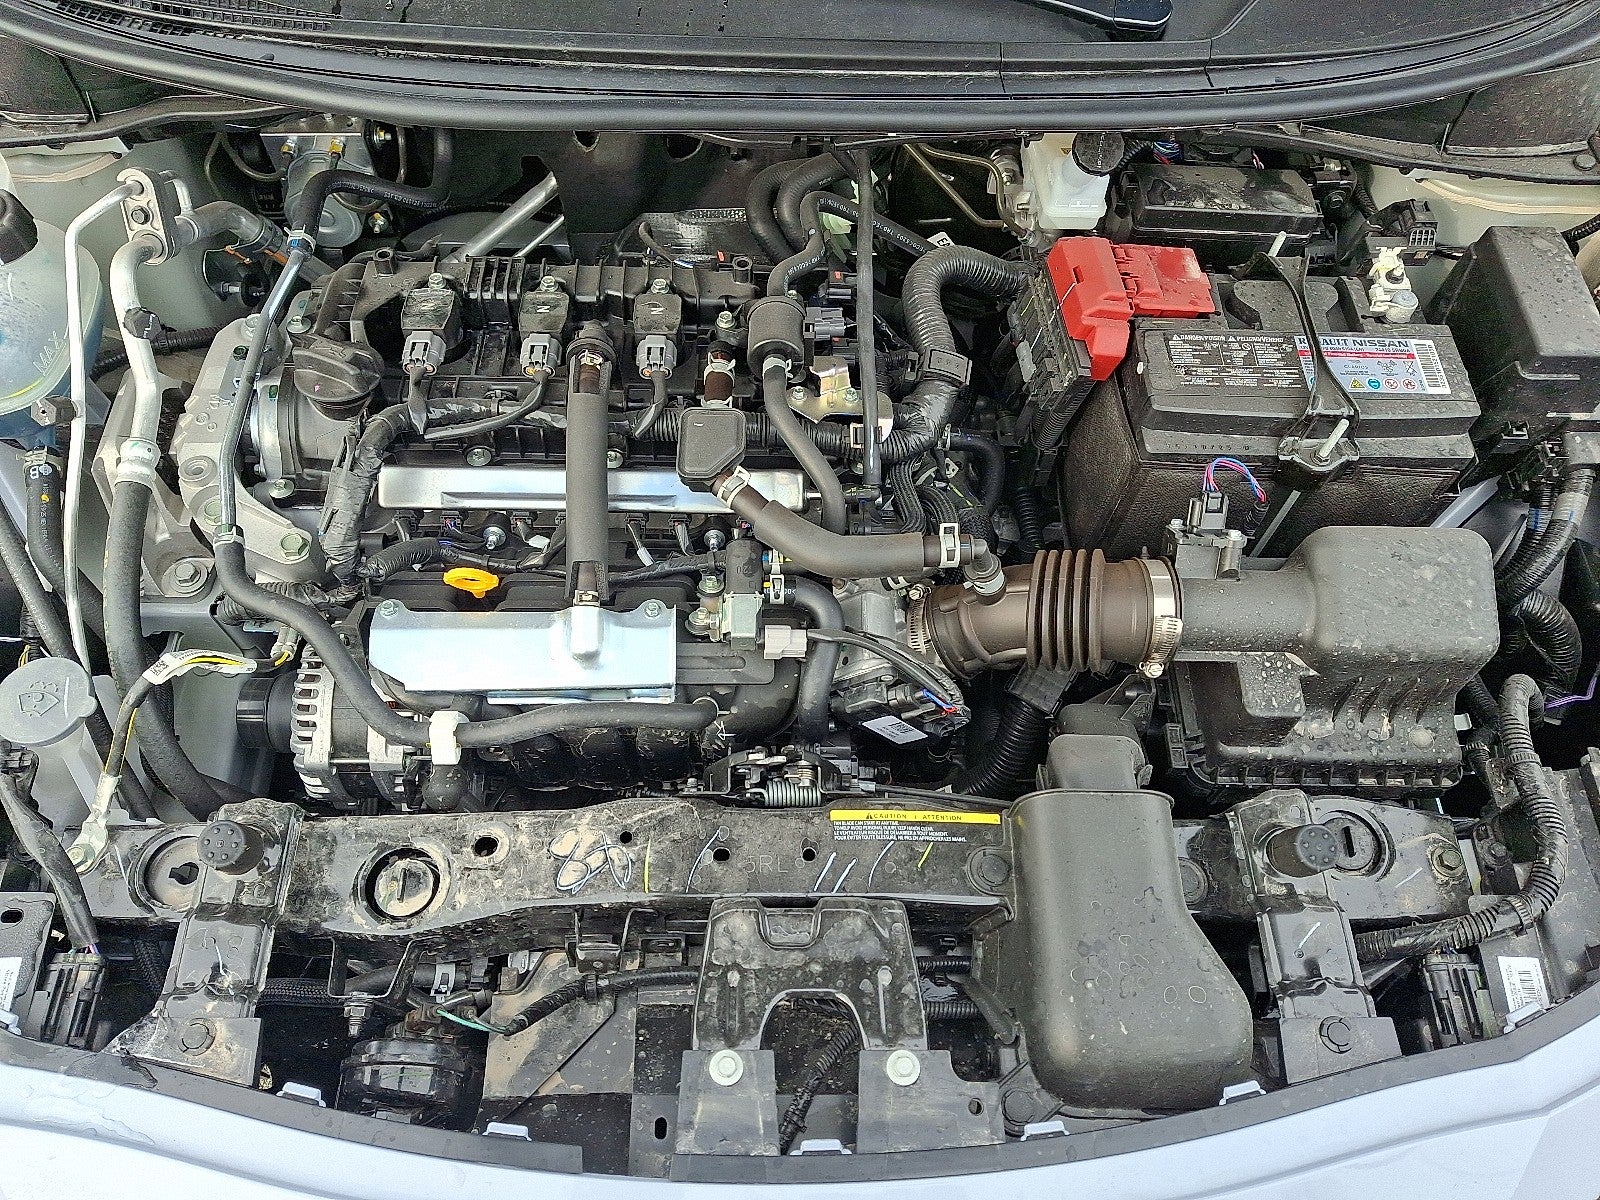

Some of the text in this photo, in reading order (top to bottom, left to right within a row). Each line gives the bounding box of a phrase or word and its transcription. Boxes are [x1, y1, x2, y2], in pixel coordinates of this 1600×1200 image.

[32, 330, 60, 377] MAX
[1298, 337, 1409, 348] RAULT NISSAN
